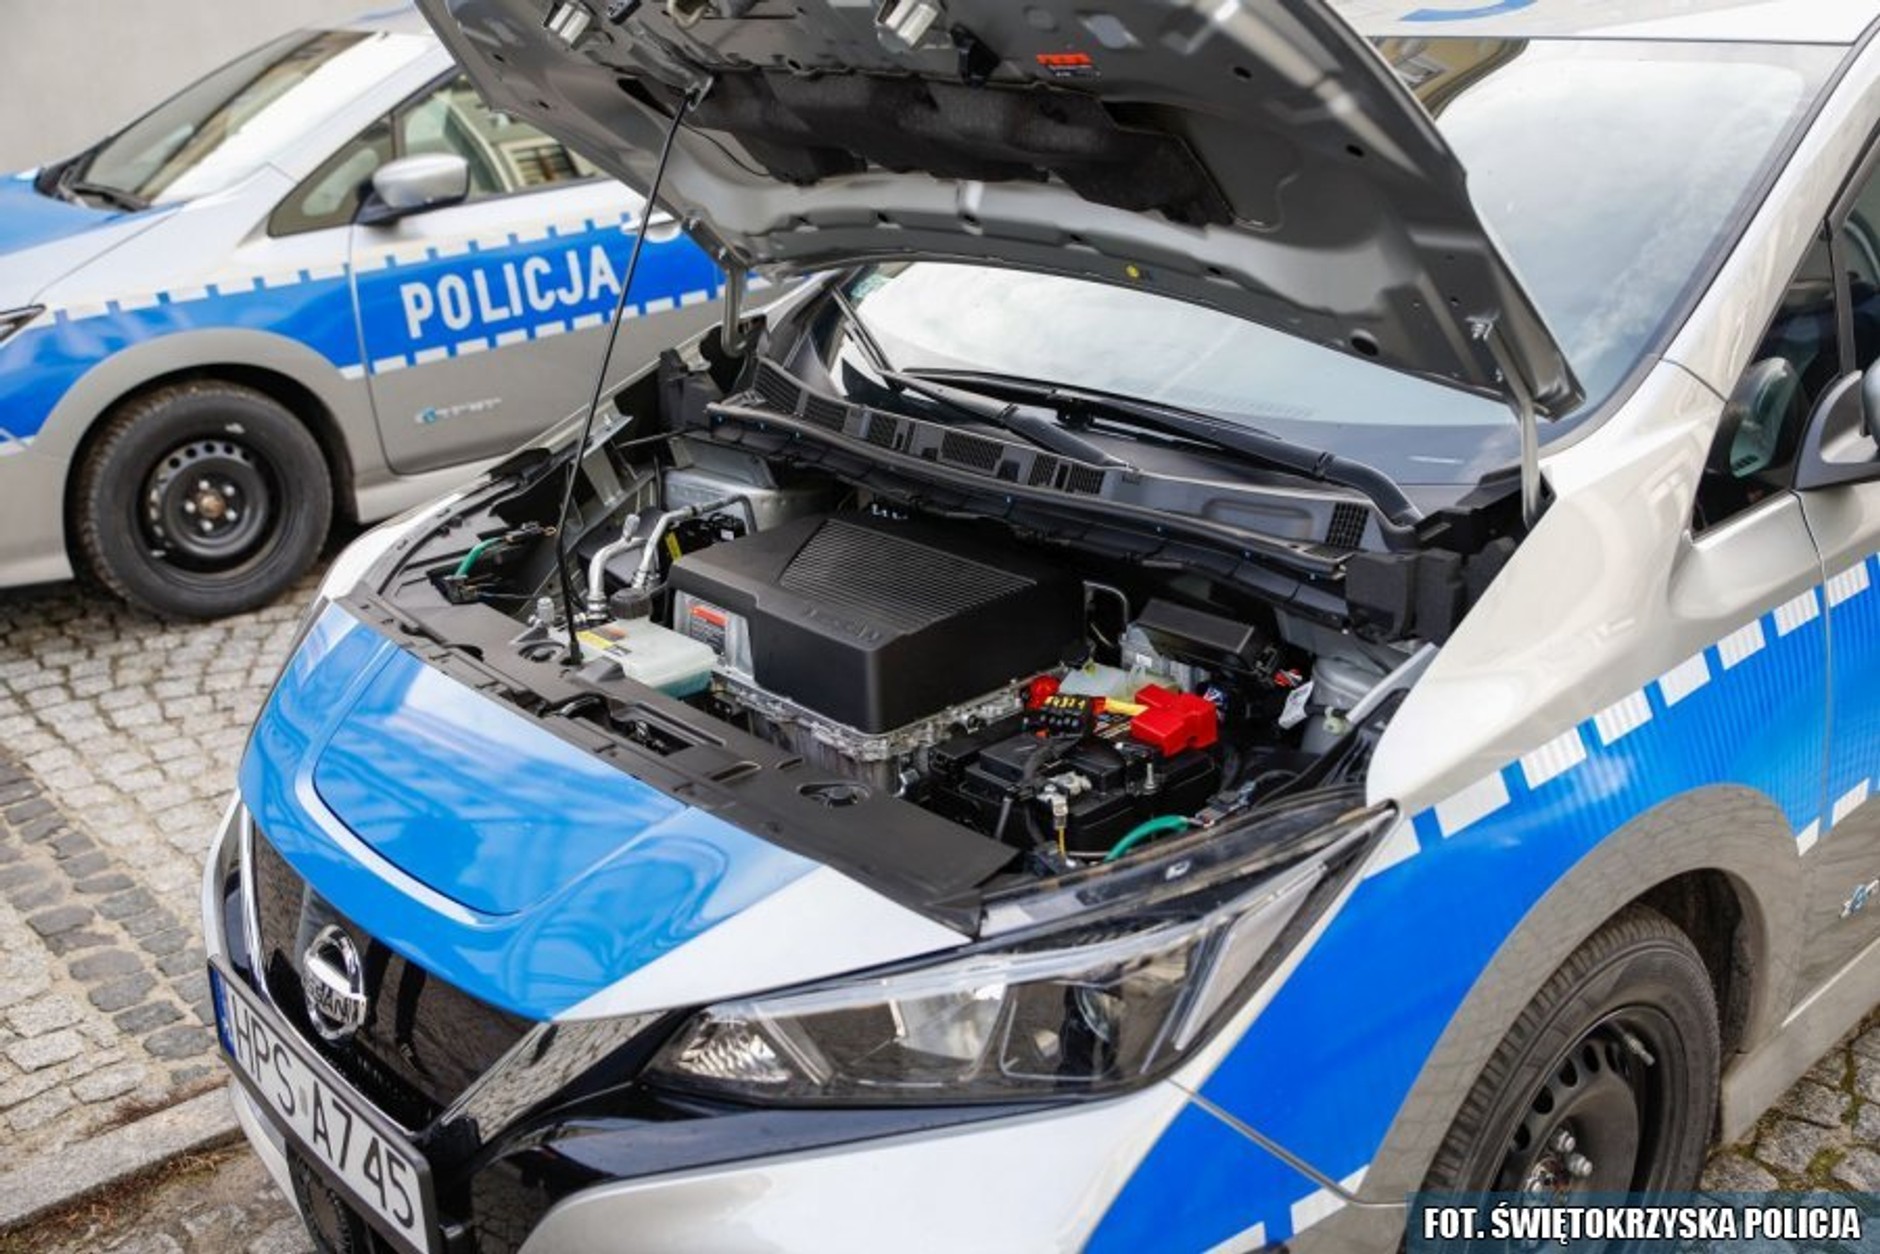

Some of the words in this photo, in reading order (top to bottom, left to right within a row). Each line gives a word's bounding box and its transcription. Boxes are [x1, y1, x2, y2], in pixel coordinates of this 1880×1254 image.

[400, 245, 621, 340] POLICJA
[231, 993, 296, 1118] HPS
[312, 1080, 415, 1231] A745
